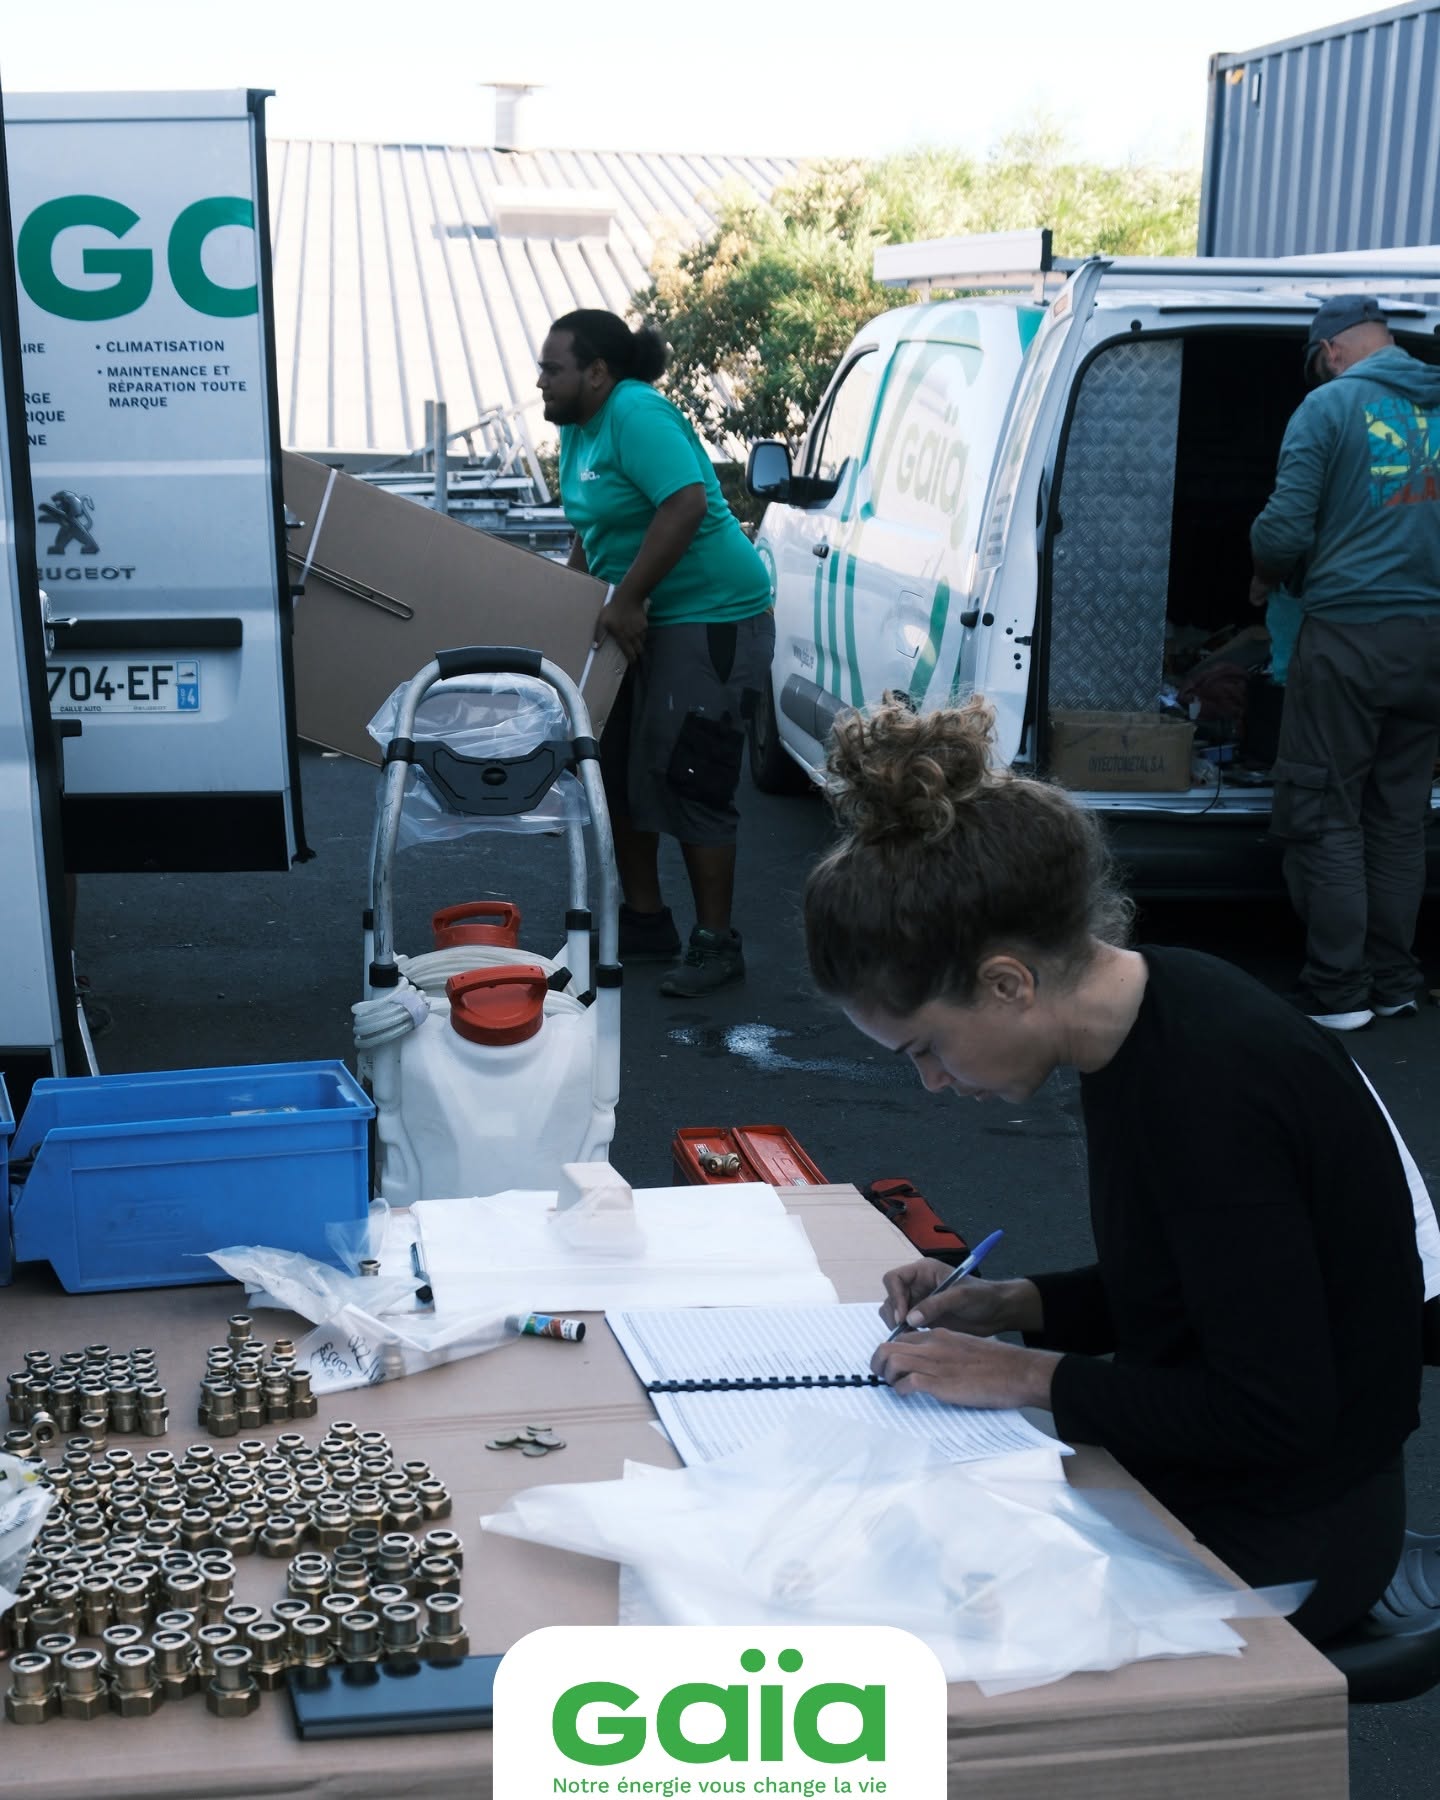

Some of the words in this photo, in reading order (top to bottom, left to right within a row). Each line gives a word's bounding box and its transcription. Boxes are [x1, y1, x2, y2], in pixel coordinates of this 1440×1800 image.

[21, 343, 45, 353] IRE
[106, 340, 225, 352] CLIMATISATION
[107, 366, 207, 377] MAINTENANCE
[213, 365, 230, 376] ET
[108, 379, 196, 393] RÉPARATION
[201, 381, 247, 392] TOUTE
[109, 397, 168, 409] MARQUE
